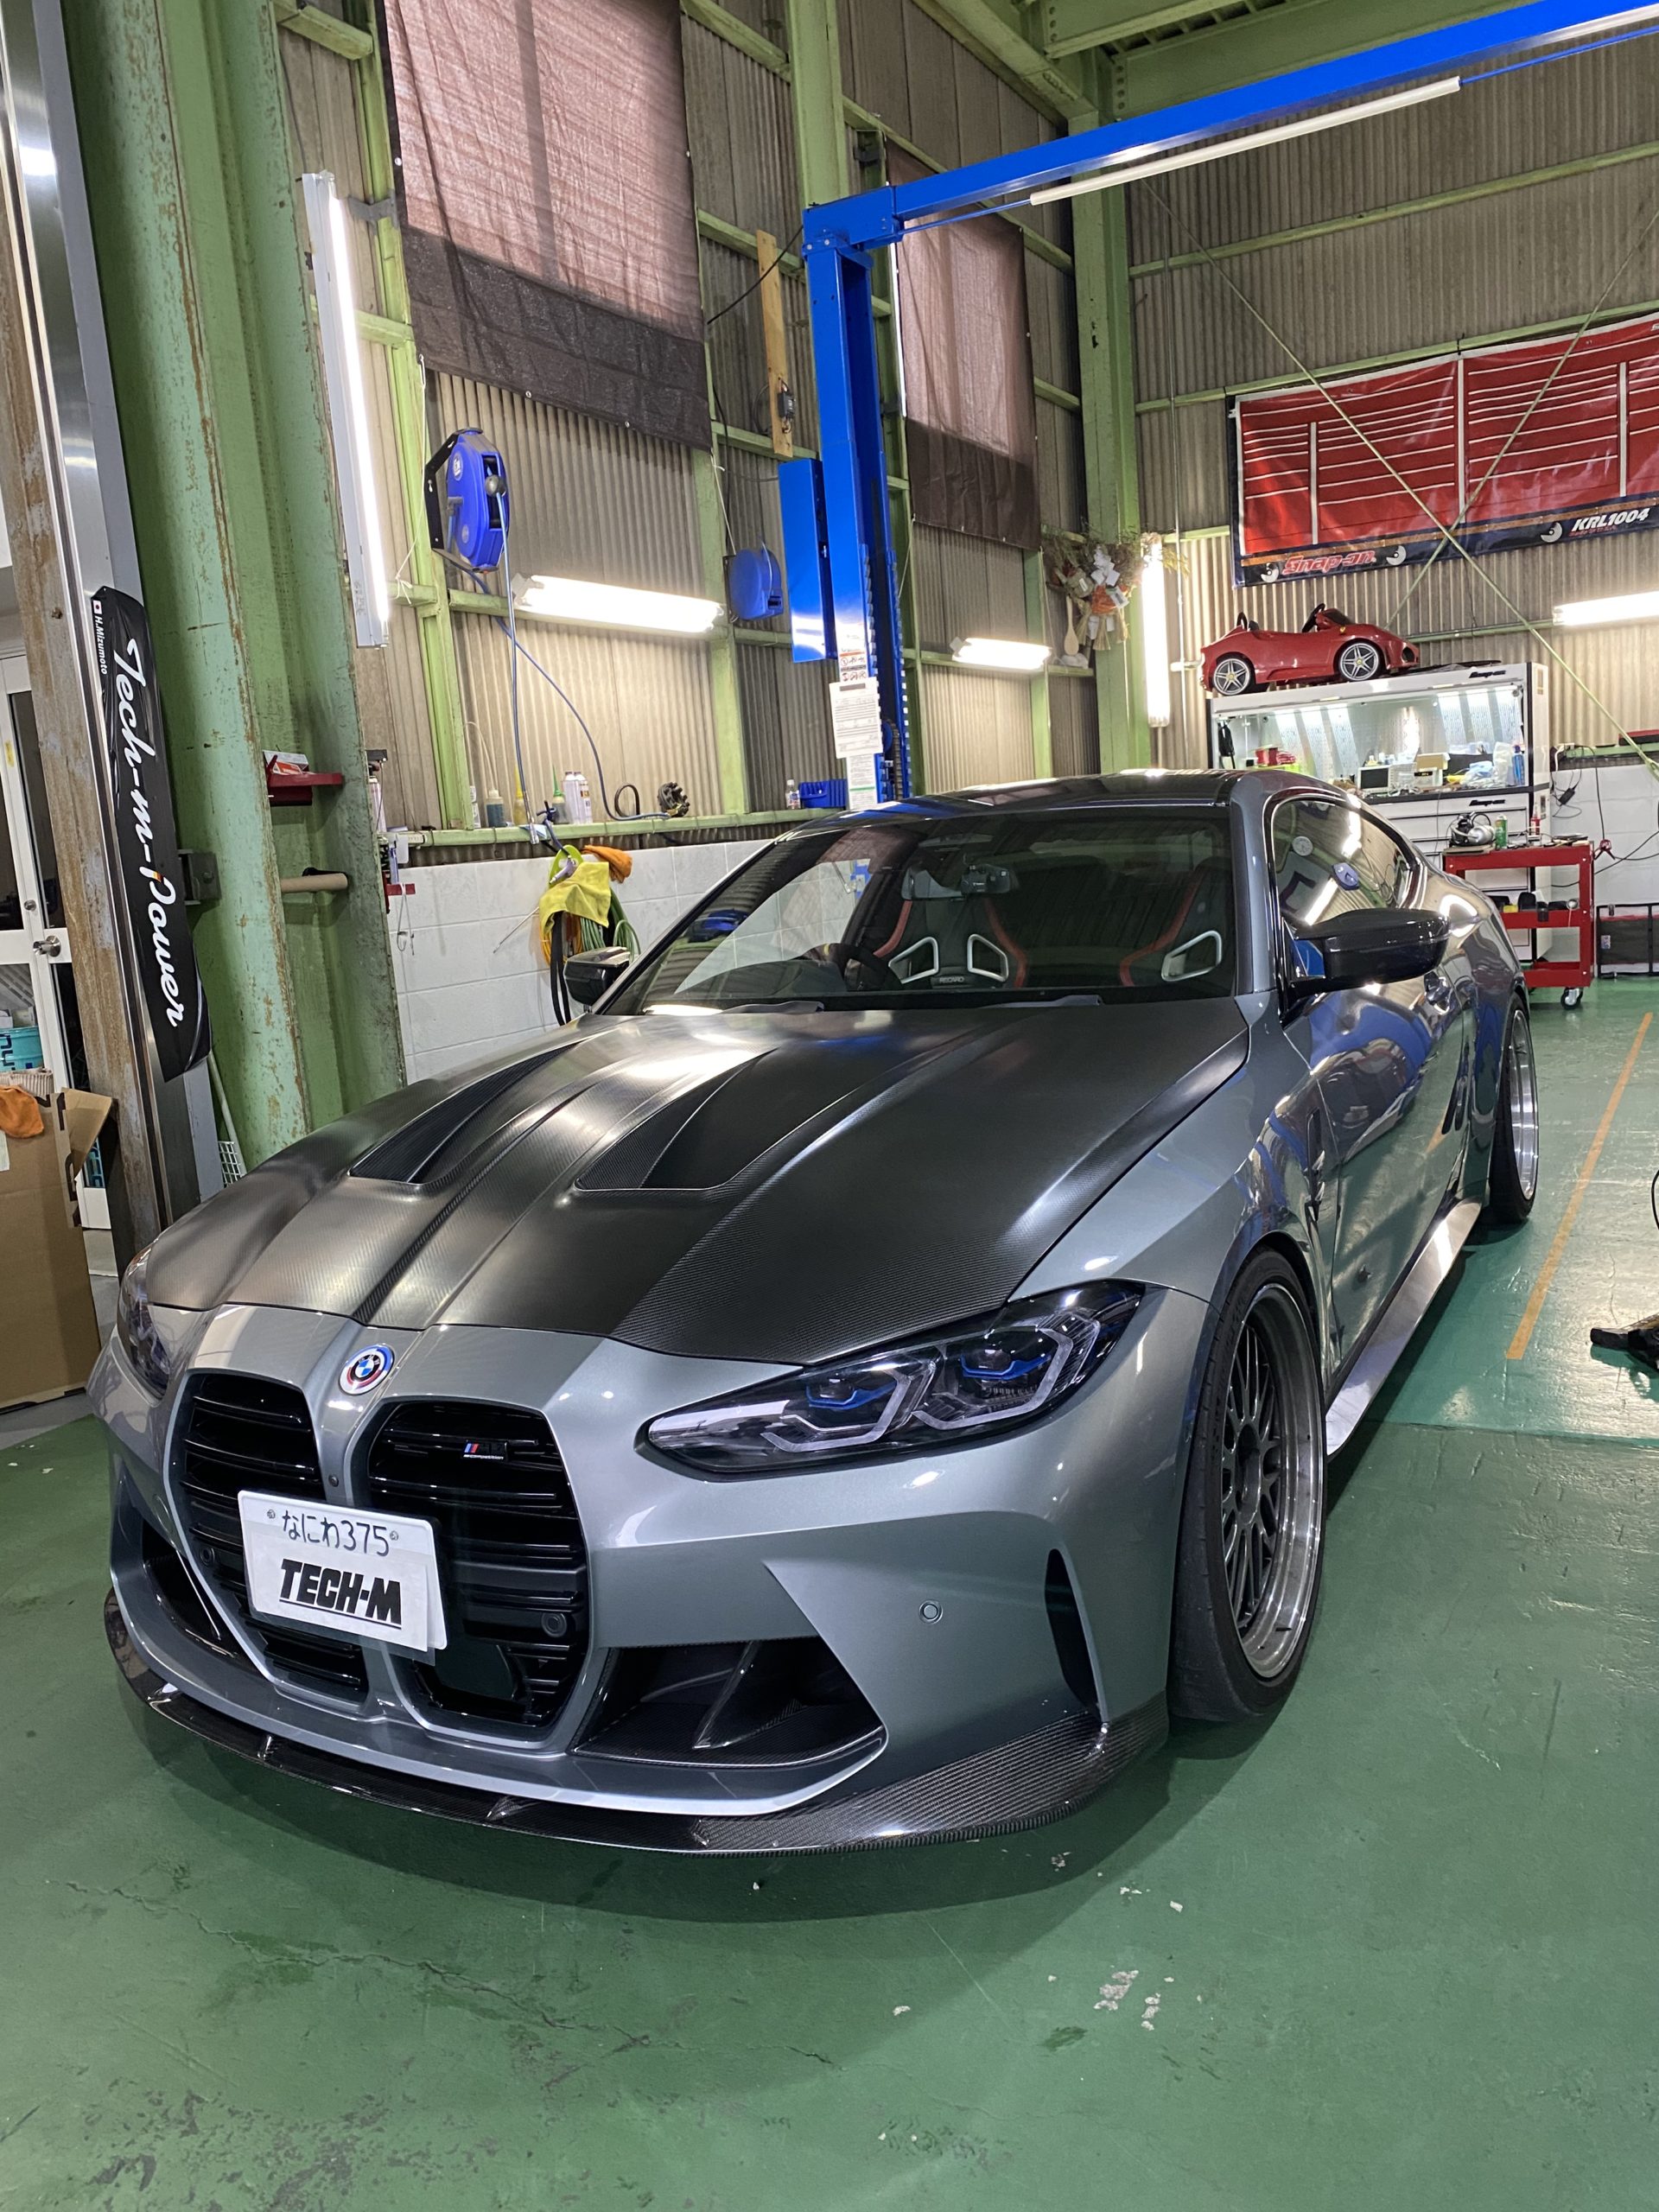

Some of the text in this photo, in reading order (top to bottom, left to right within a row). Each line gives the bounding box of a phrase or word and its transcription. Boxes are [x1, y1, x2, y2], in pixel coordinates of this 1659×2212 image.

[1571, 508, 1650, 532] KRL1004
[1282, 551, 1376, 575] Snap-on
[94, 615, 107, 675] H.Mizumoto
[280, 1559, 402, 1625] TECH-M
